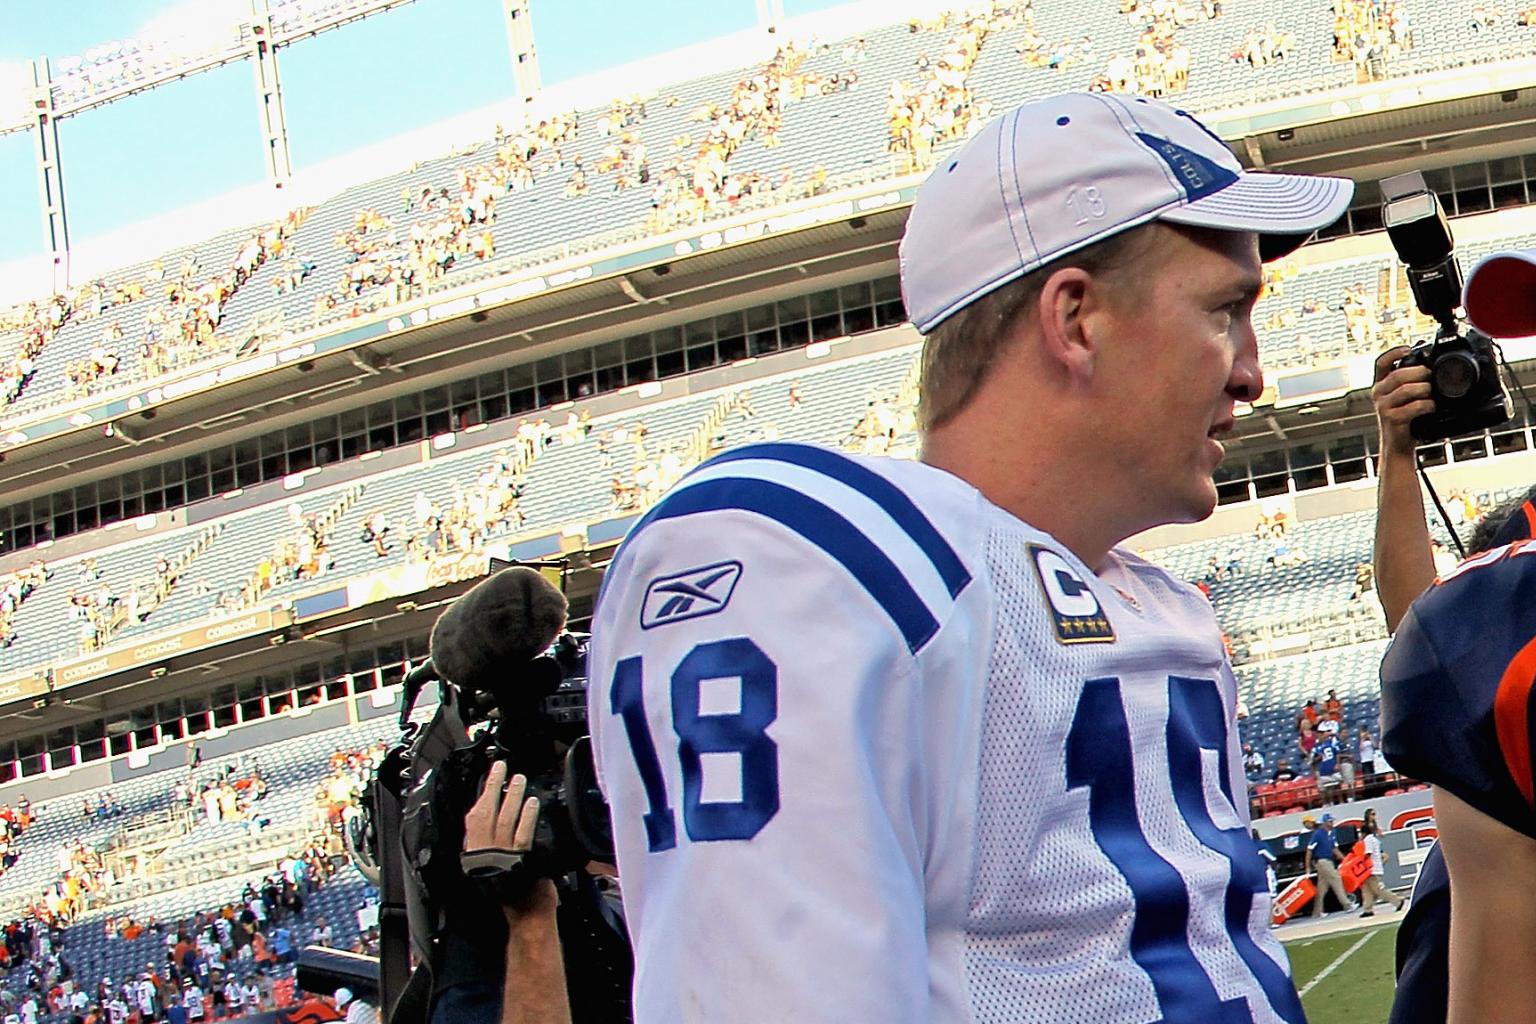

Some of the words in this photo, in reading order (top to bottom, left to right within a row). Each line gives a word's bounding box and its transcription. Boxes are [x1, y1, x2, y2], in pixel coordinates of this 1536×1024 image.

[1160, 143, 1204, 189] COLTS
[1066, 185, 1107, 227] 18
[1036, 550, 1100, 616] C
[610, 637, 780, 853] 18
